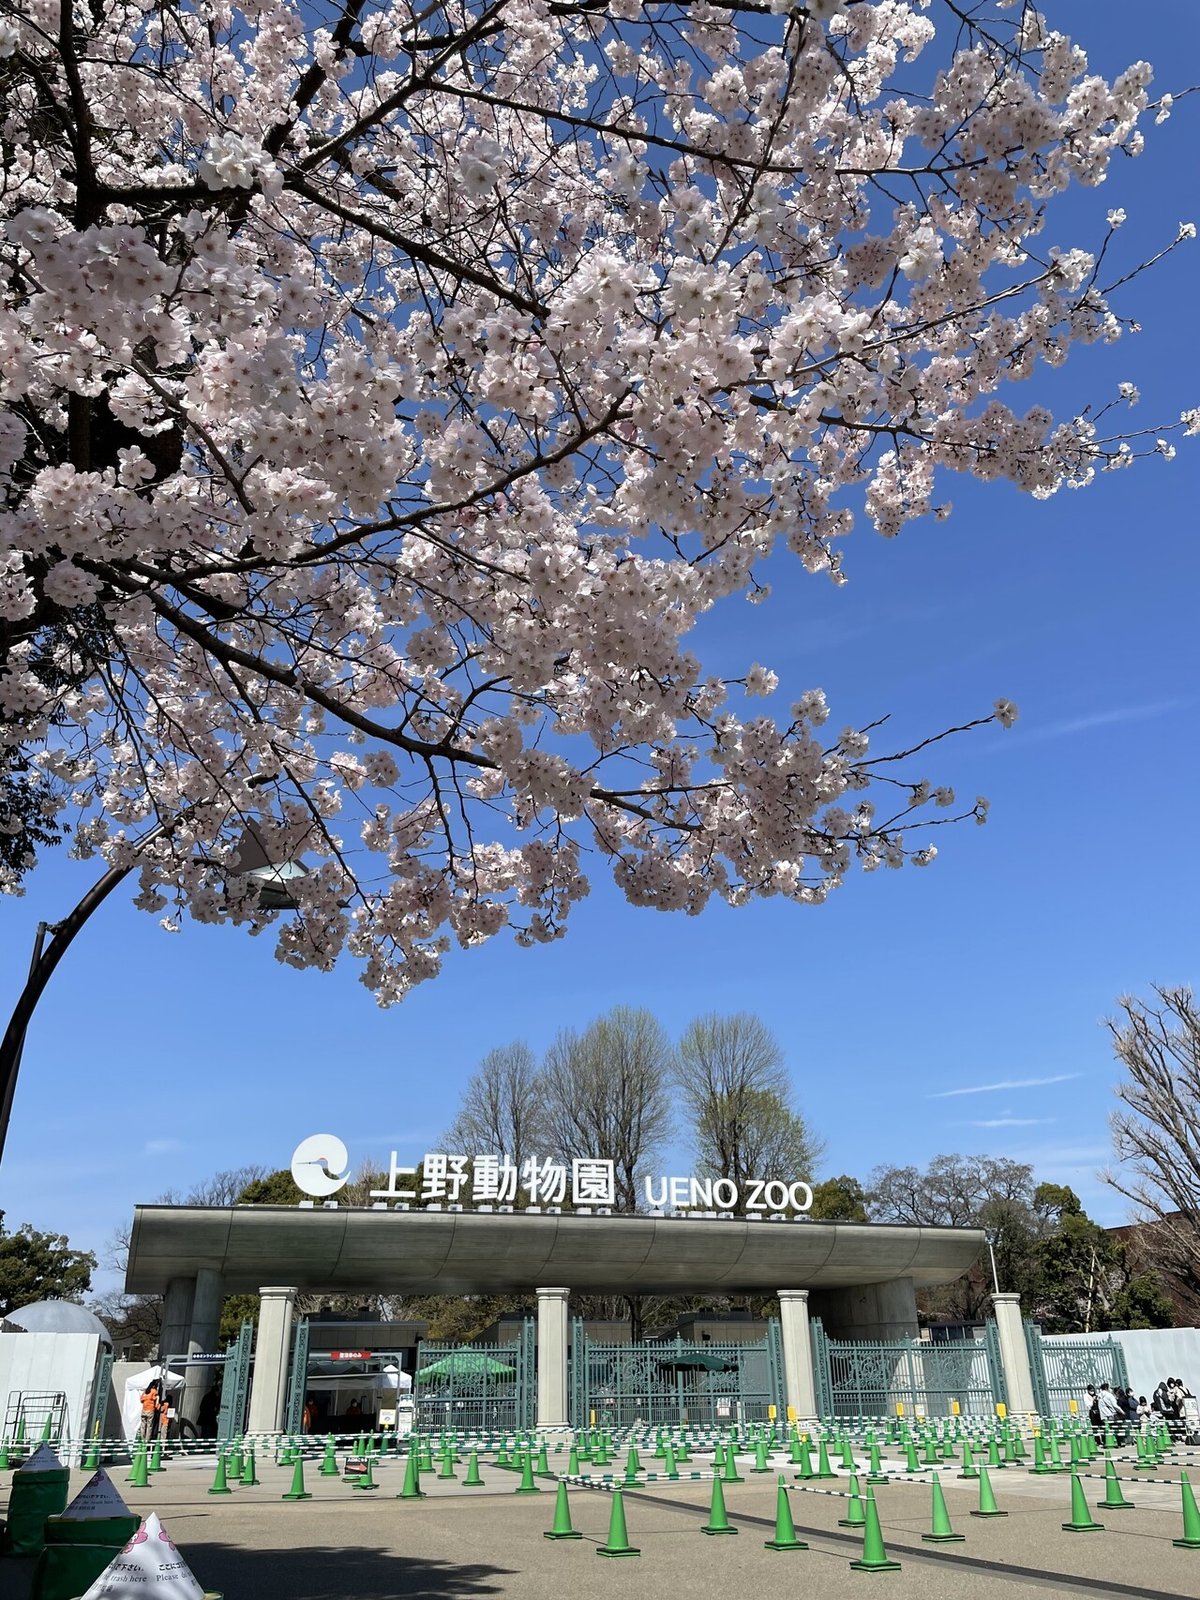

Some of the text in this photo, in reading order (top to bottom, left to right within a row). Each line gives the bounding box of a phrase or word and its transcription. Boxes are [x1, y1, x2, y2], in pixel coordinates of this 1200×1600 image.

[369, 1150, 615, 1204] 上野動物園
[644, 1175, 814, 1211] UENO ZOO
[110, 1575, 128, 1583] trash
[129, 1575, 148, 1583] here
[156, 1574, 179, 1582] Please
